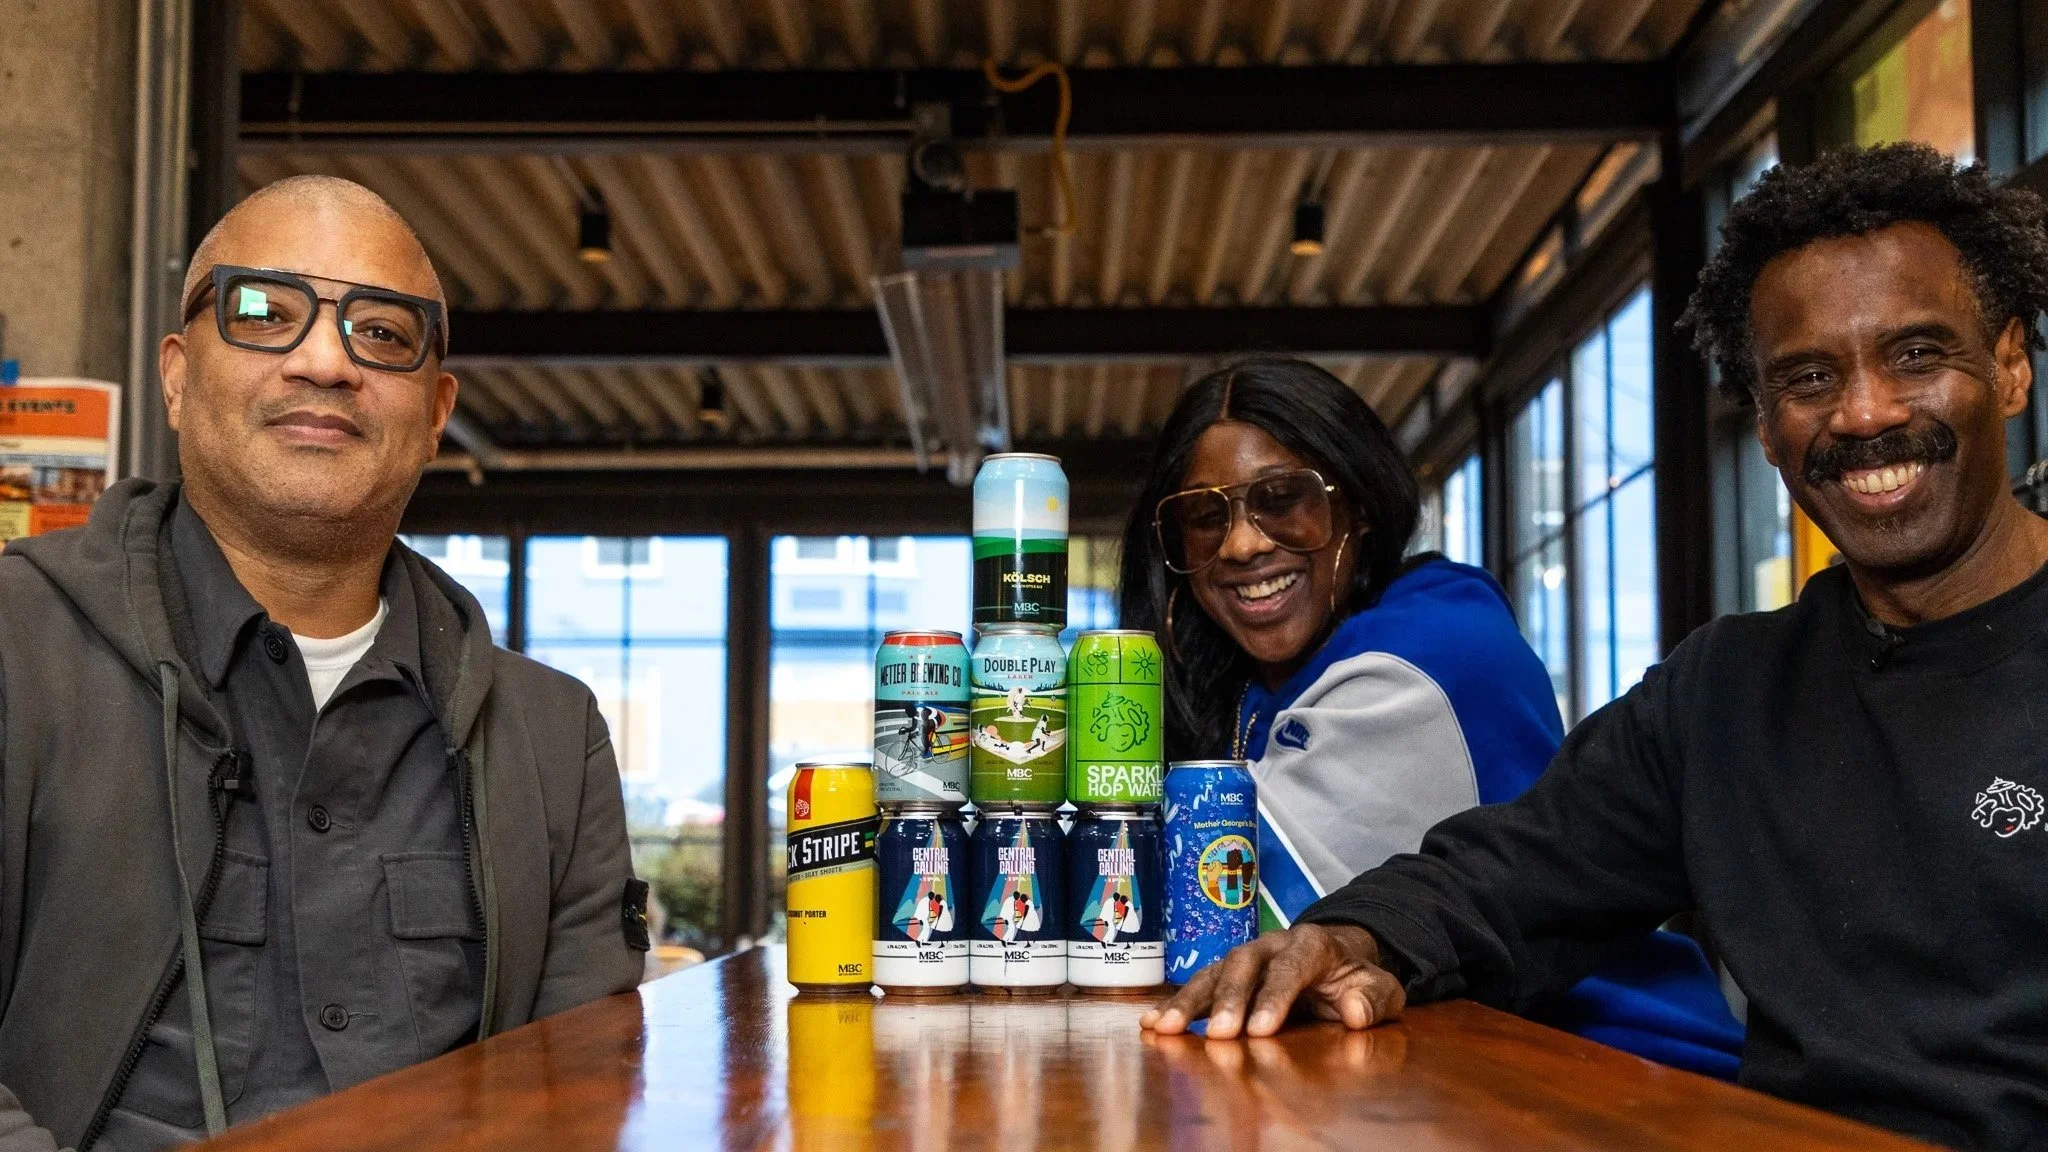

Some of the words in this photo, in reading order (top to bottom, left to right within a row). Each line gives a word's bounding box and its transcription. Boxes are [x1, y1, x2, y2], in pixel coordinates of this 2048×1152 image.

[1003, 571, 1051, 584] KÖLSCH
[1014, 602, 1040, 612] MBC
[984, 658, 1028, 673] DOUBLE
[1030, 657, 1056, 673] PLAY
[880, 663, 906, 687] METIER
[1007, 768, 1033, 778] MBC
[943, 781, 961, 790] MBC
[1088, 783, 1124, 797] HOP
[1220, 793, 1244, 802] MBC
[1194, 820, 1221, 829] Mother
[803, 831, 860, 864] STRIPE
[912, 847, 949, 861] CENTRAL
[998, 846, 1036, 860] CENTRAL
[1097, 848, 1136, 862] CENTRAL
[914, 861, 948, 875] CALLING
[999, 860, 1035, 874] CALLING
[1099, 862, 1135, 876] CALLING
[918, 951, 944, 960] MBC
[1004, 951, 1030, 960] MBC
[1104, 952, 1130, 961] MBC
[838, 964, 862, 973] MBC
